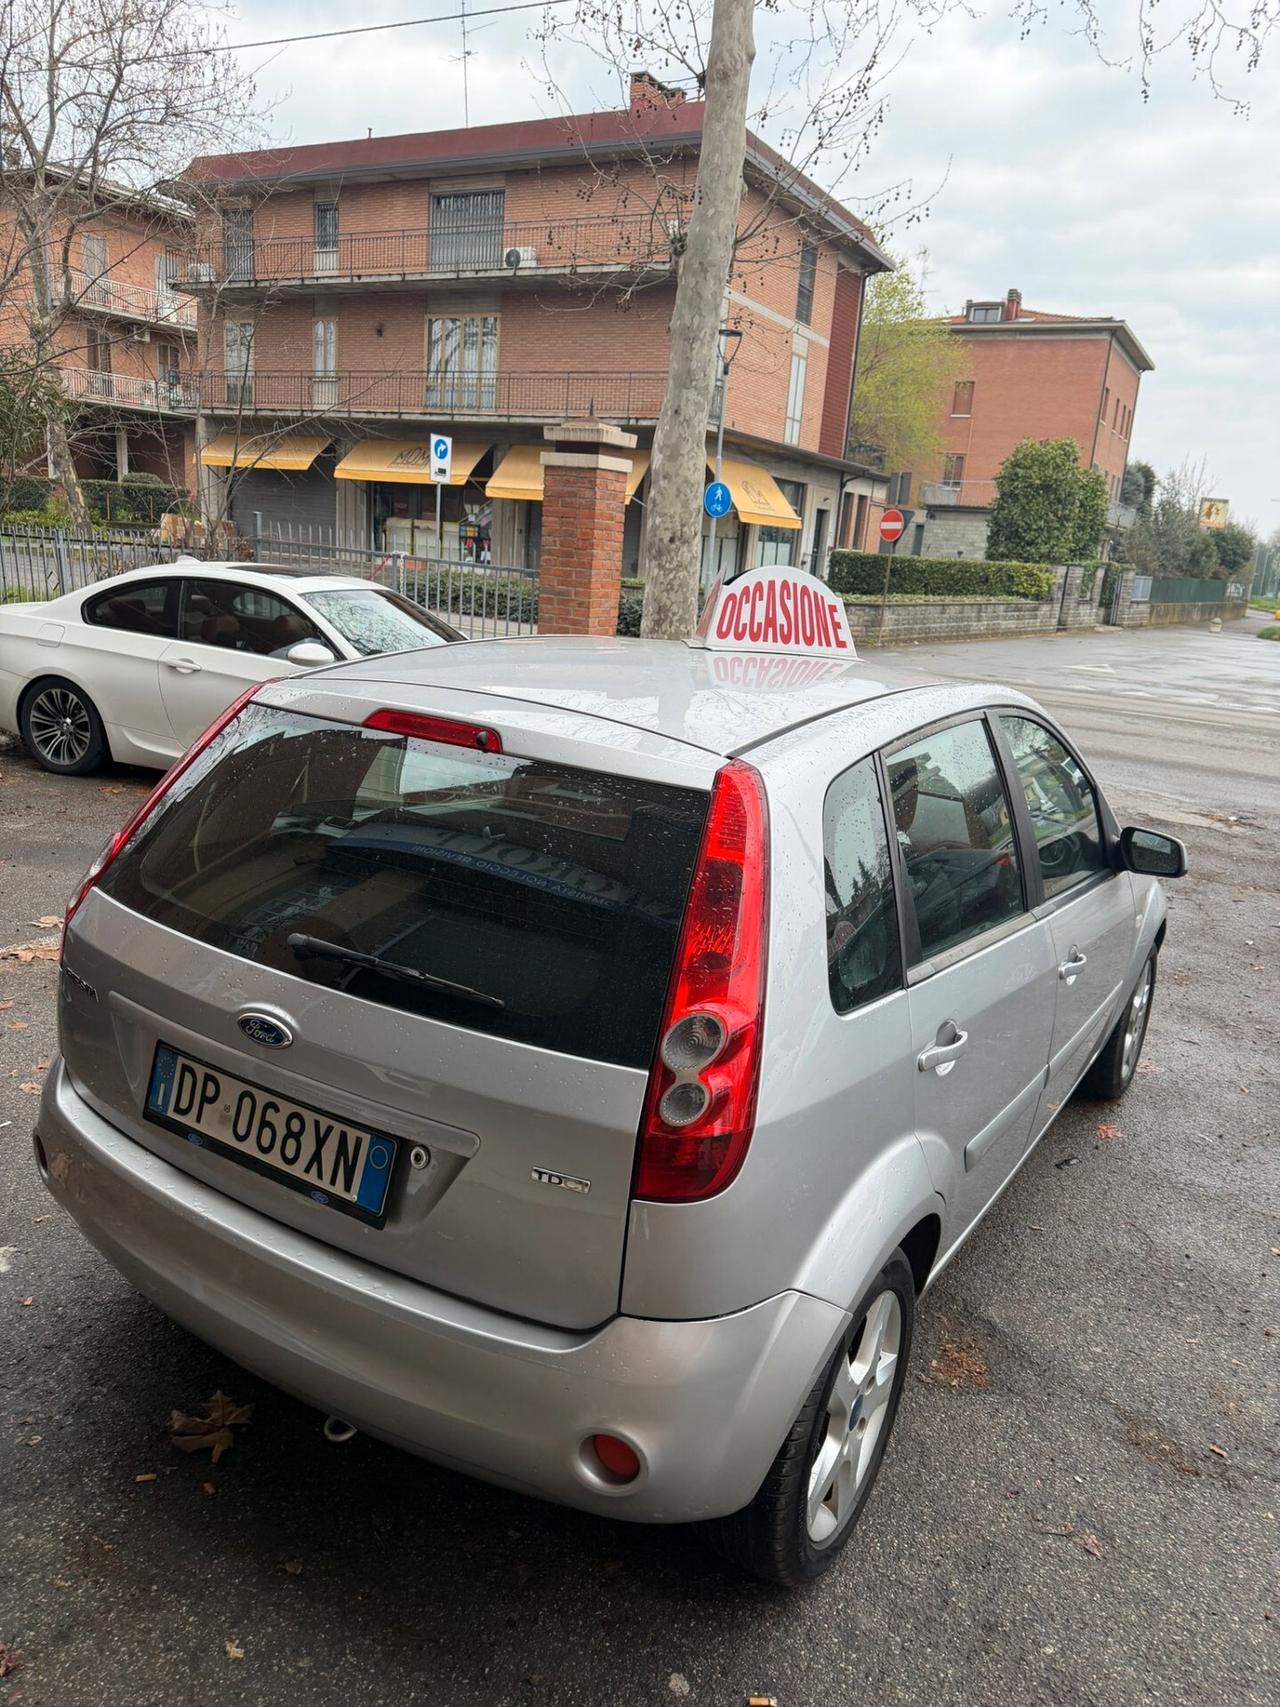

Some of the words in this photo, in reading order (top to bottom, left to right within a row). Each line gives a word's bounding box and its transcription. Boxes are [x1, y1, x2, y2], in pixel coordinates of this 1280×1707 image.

[716, 579, 847, 648] OCCASIONE
[245, 1019, 276, 1044] Ford
[173, 1063, 221, 1124] DP
[232, 1090, 363, 1193] 068XN
